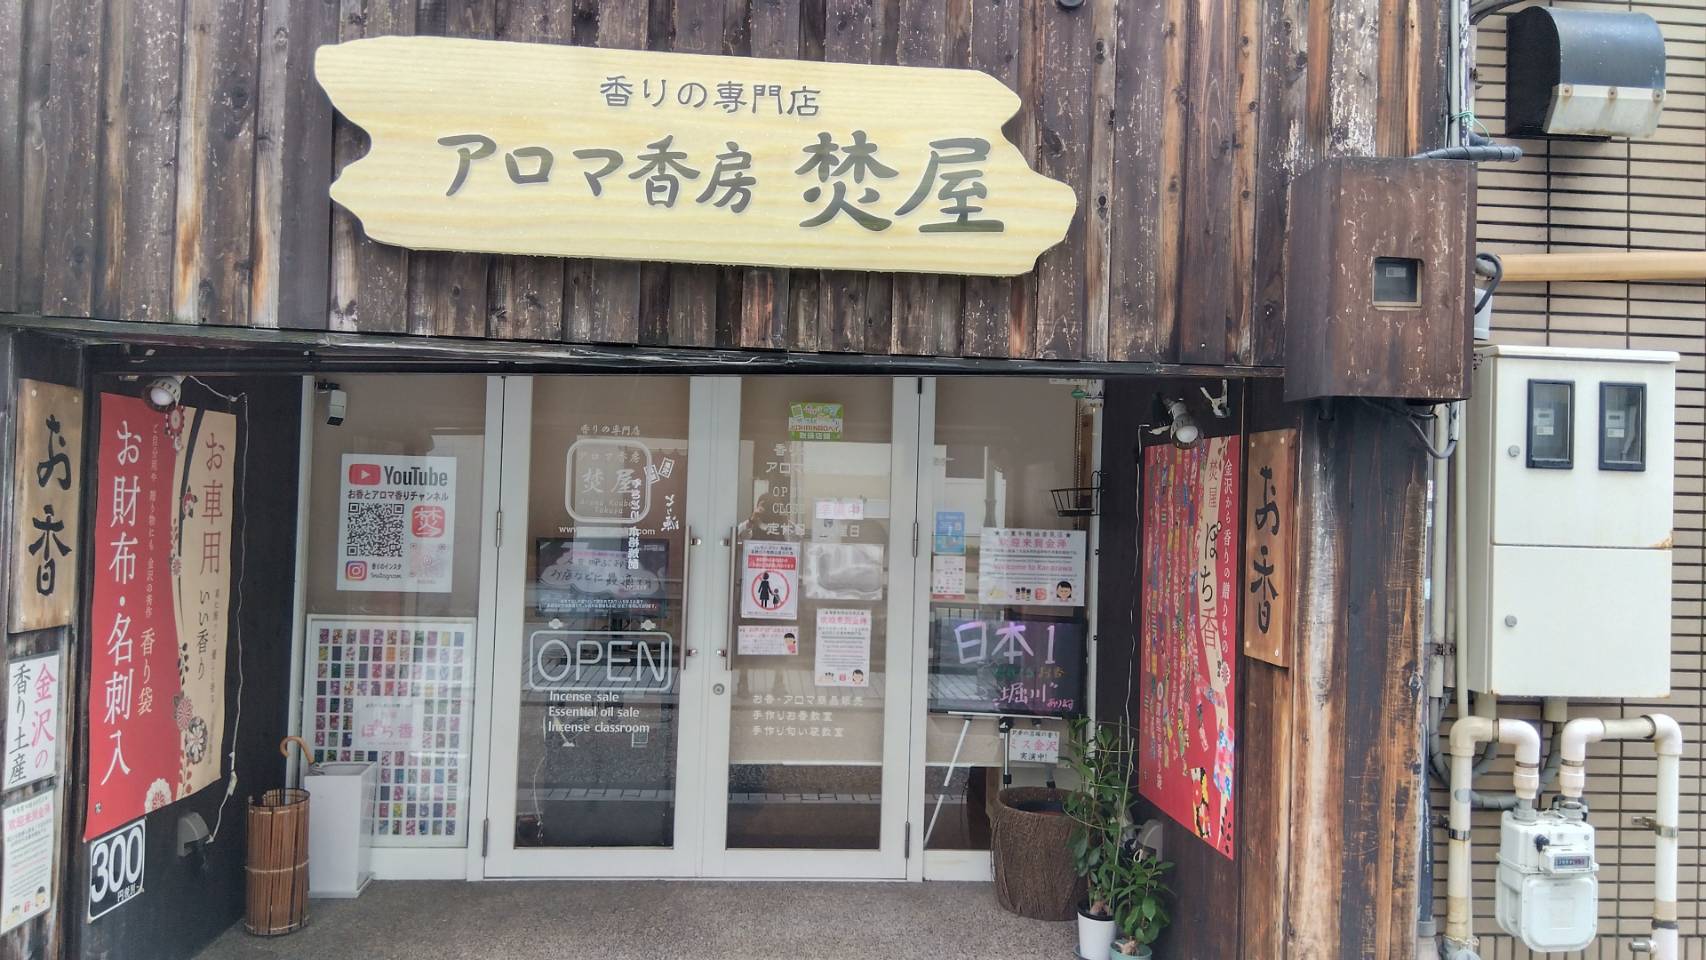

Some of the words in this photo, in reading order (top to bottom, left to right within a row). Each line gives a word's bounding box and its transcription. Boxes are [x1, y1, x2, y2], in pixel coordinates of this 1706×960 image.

[598, 75, 822, 117] 香りの専門店
[437, 134, 758, 214] アロマ香房
[795, 130, 1005, 234] 焚屋
[28, 414, 72, 596] お香
[200, 432, 225, 574] お車用
[347, 490, 449, 501] お香とアロマ香りチャンネル
[384, 466, 448, 486] YouTube
[1250, 465, 1280, 634] お香
[101, 420, 142, 786] お財布・名刺入
[137, 627, 155, 716] 香り袋
[537, 639, 666, 682] OPEN
[550, 691, 591, 702] Incense
[597, 692, 619, 702] sale
[8, 664, 32, 785] 香り土産
[31, 663, 57, 769] 金沢の
[548, 721, 590, 732] Incense
[595, 722, 650, 733] classroom
[549, 707, 597, 717] Essential
[600, 707, 613, 717] oil
[617, 707, 640, 718] sale
[91, 826, 142, 902] 300
